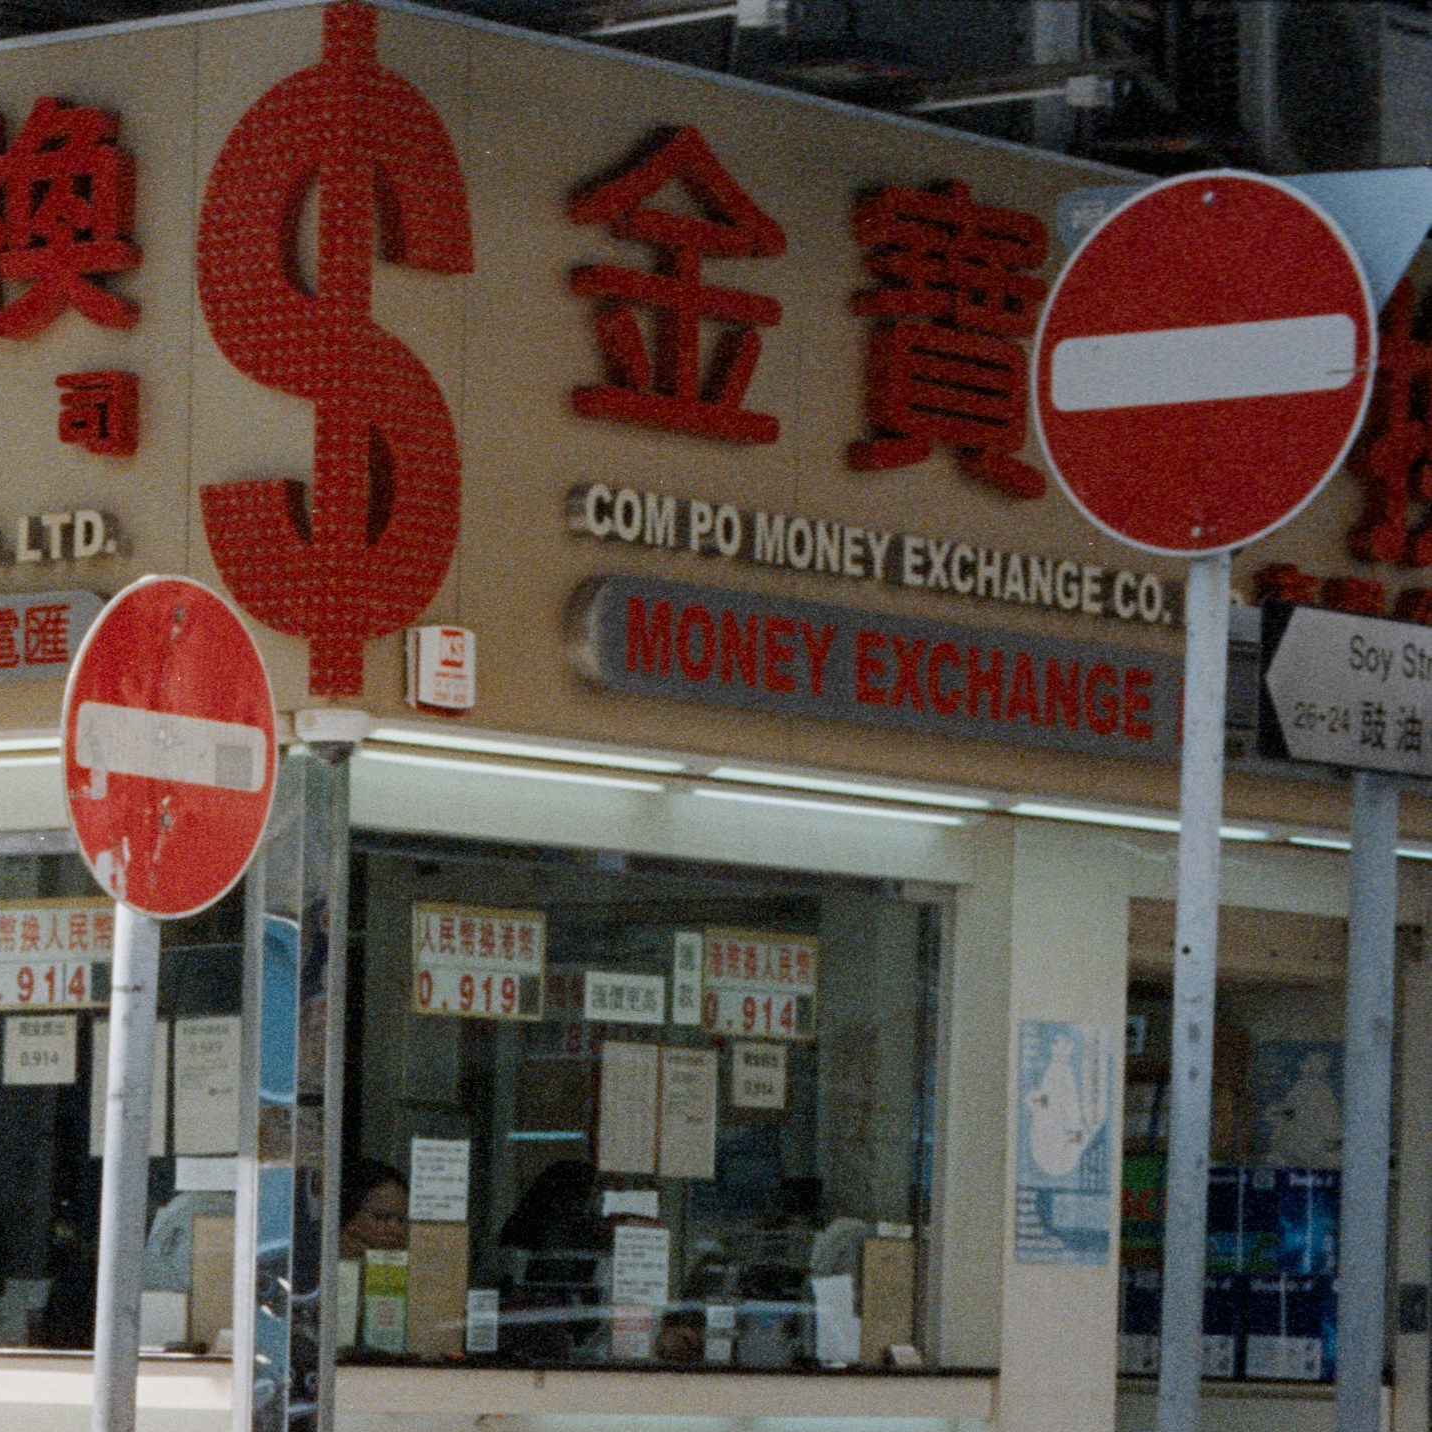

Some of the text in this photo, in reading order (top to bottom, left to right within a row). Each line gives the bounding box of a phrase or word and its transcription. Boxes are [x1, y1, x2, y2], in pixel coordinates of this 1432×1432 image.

[15, 510, 117, 564] LTD.
[584, 484, 1171, 624] COM PO MONEY EXCHANGE CO.
[626, 595, 1154, 744] MONEY EXCHANGE
[1349, 634, 1393, 682] Soy
[1360, 701, 1432, 752] 豉油
[419, 970, 515, 1013] 0.919
[702, 992, 793, 1034] 0.914
